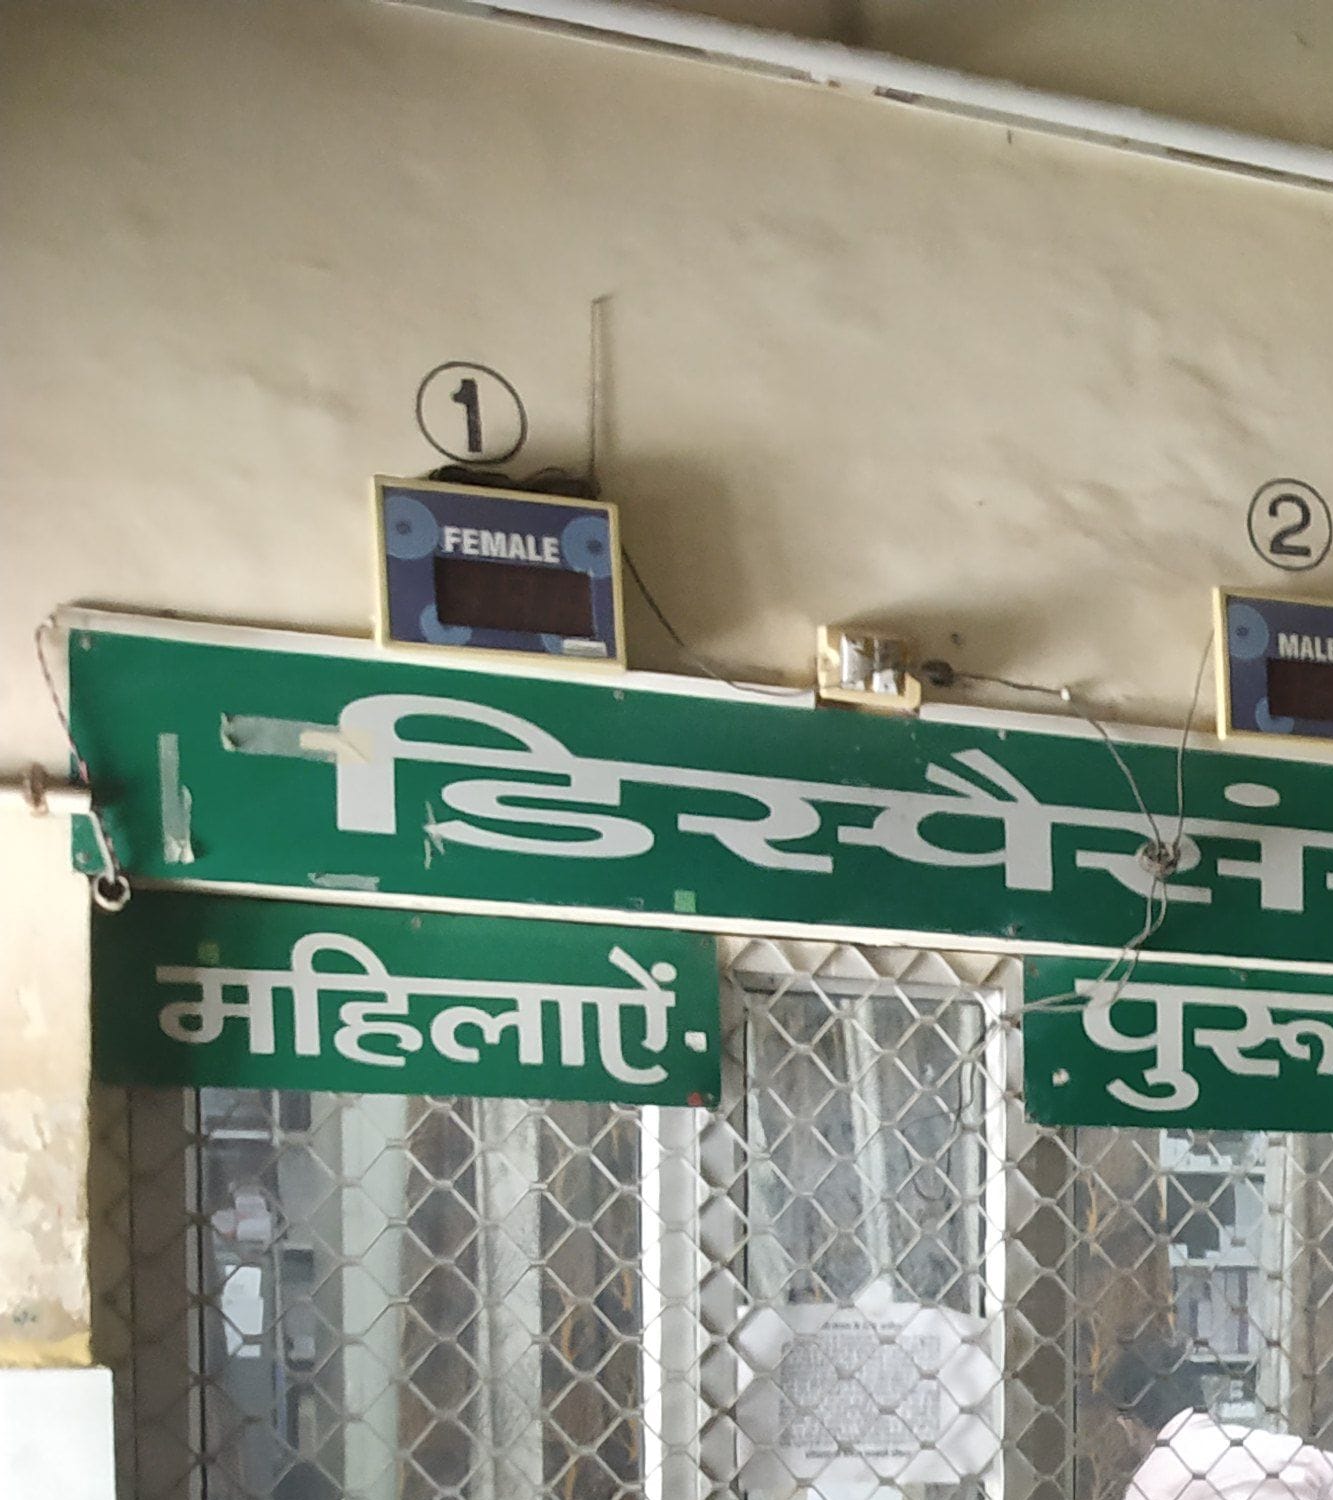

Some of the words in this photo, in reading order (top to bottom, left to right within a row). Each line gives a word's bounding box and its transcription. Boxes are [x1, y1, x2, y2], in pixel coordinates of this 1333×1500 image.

[453, 378, 482, 453] 1
[443, 525, 561, 563] FEMALE
[1269, 493, 1311, 557] 2
